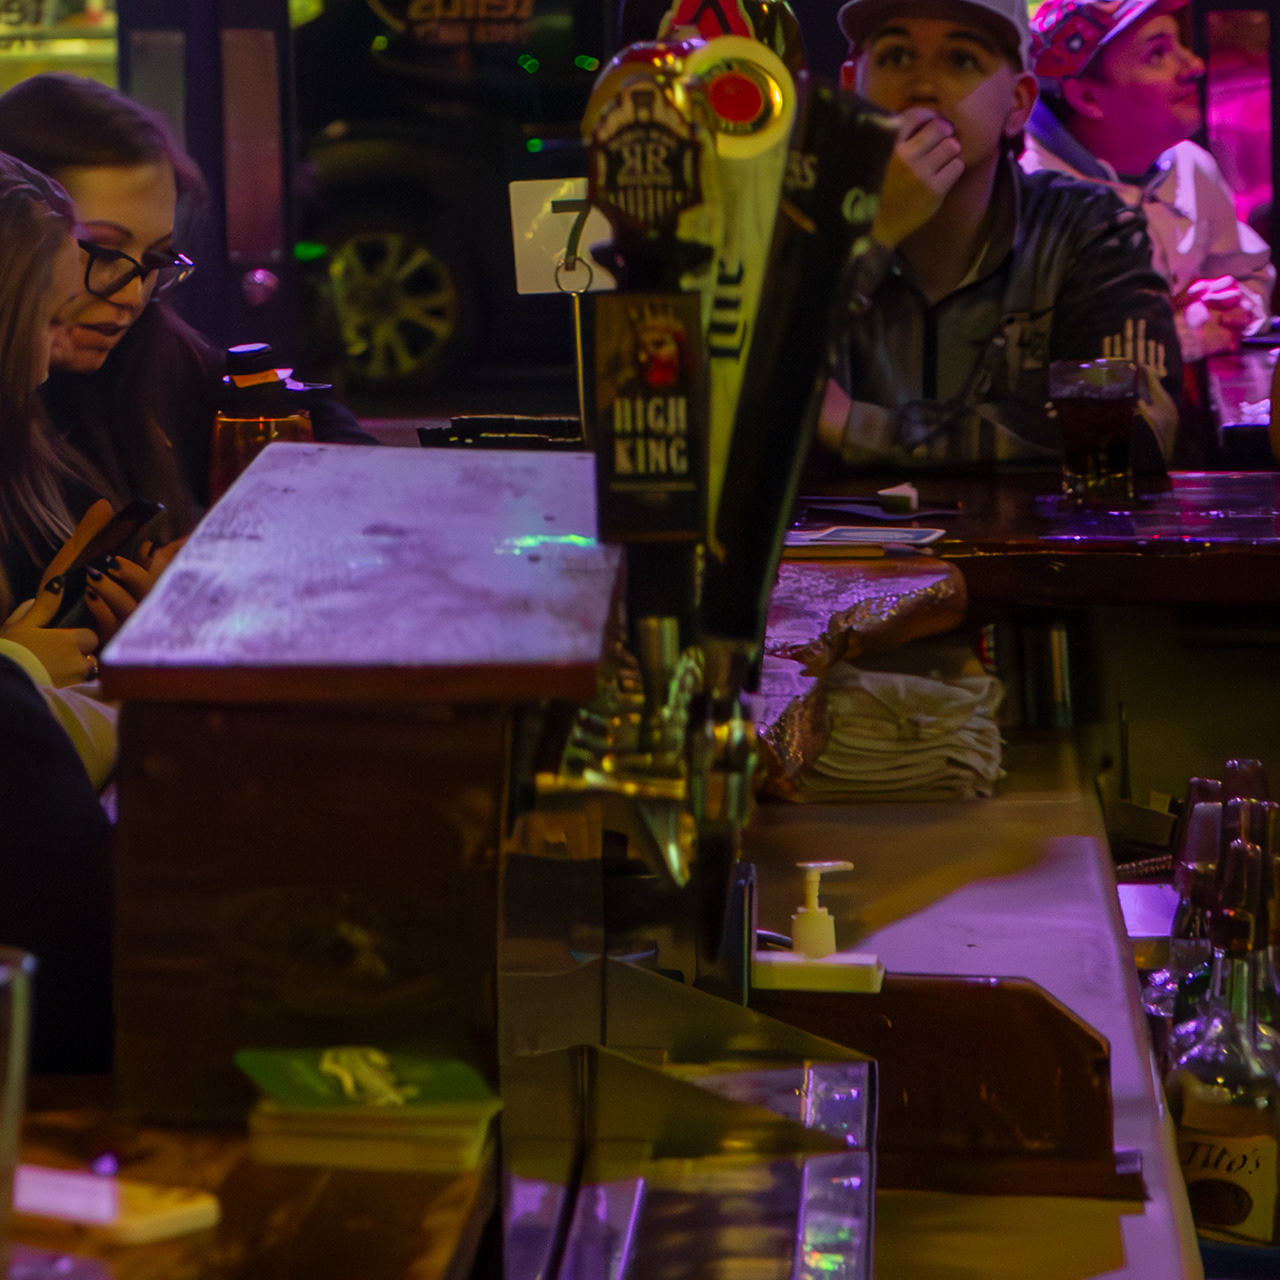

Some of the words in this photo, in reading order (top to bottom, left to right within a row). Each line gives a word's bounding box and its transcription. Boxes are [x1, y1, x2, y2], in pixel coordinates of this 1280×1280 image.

[551, 199, 592, 271] 7
[613, 395, 689, 434] HIGH
[614, 436, 690, 476] KING
